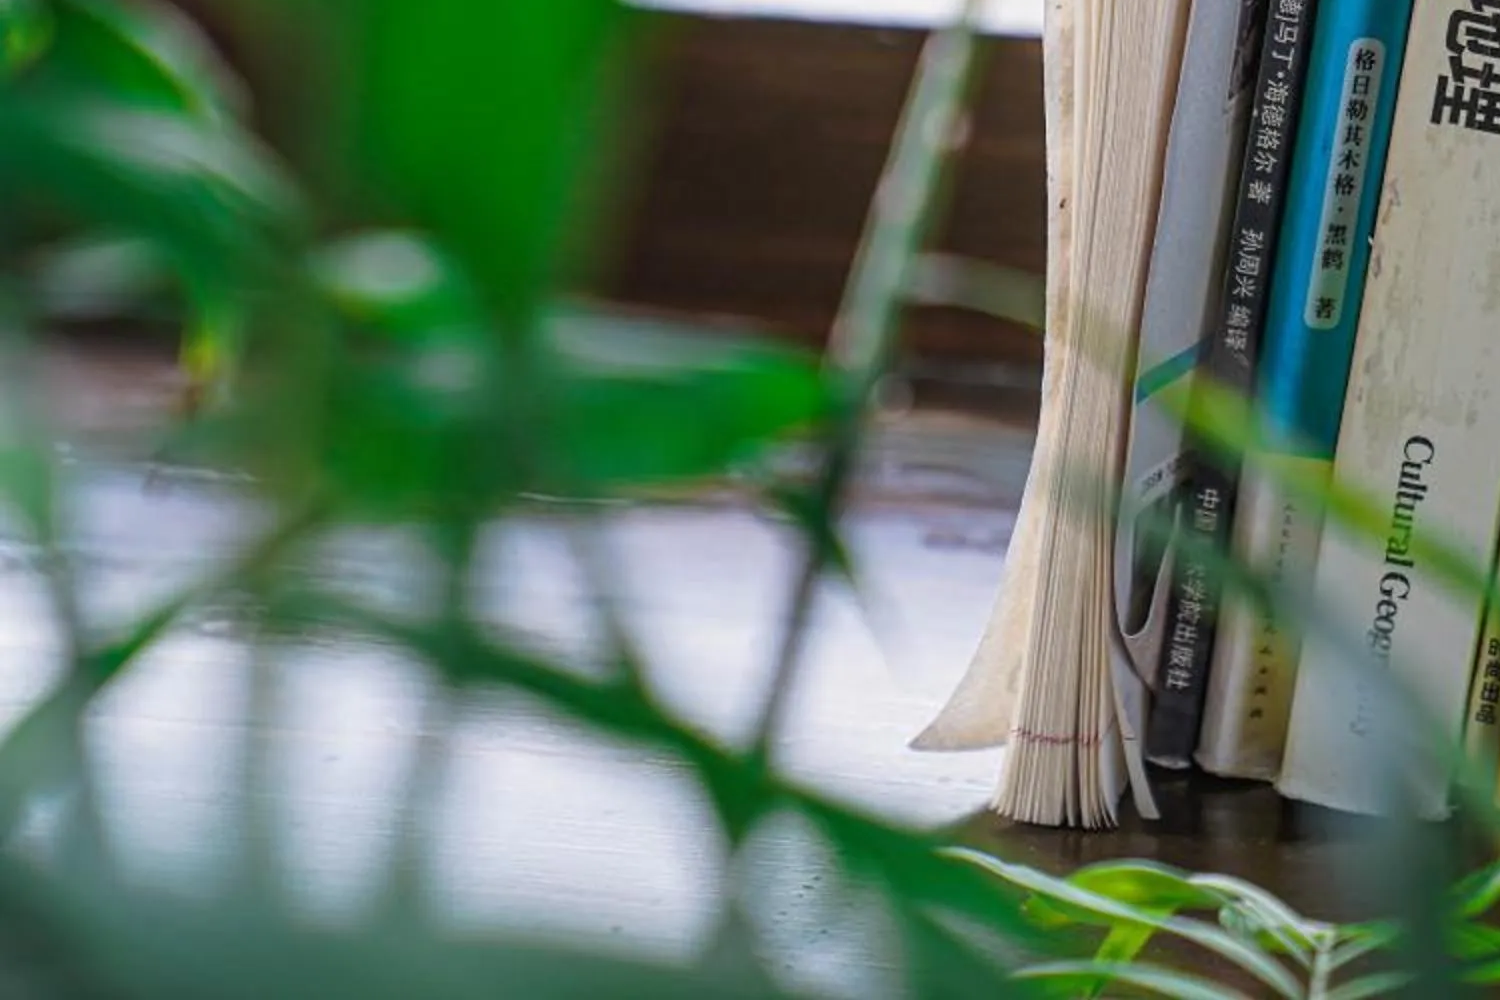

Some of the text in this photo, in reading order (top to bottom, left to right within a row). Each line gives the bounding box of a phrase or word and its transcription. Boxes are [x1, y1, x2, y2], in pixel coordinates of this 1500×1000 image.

[1247, 180, 1273, 205] 著
[1313, 297, 1337, 320] 著
[1386, 434, 1435, 568] Cultural
